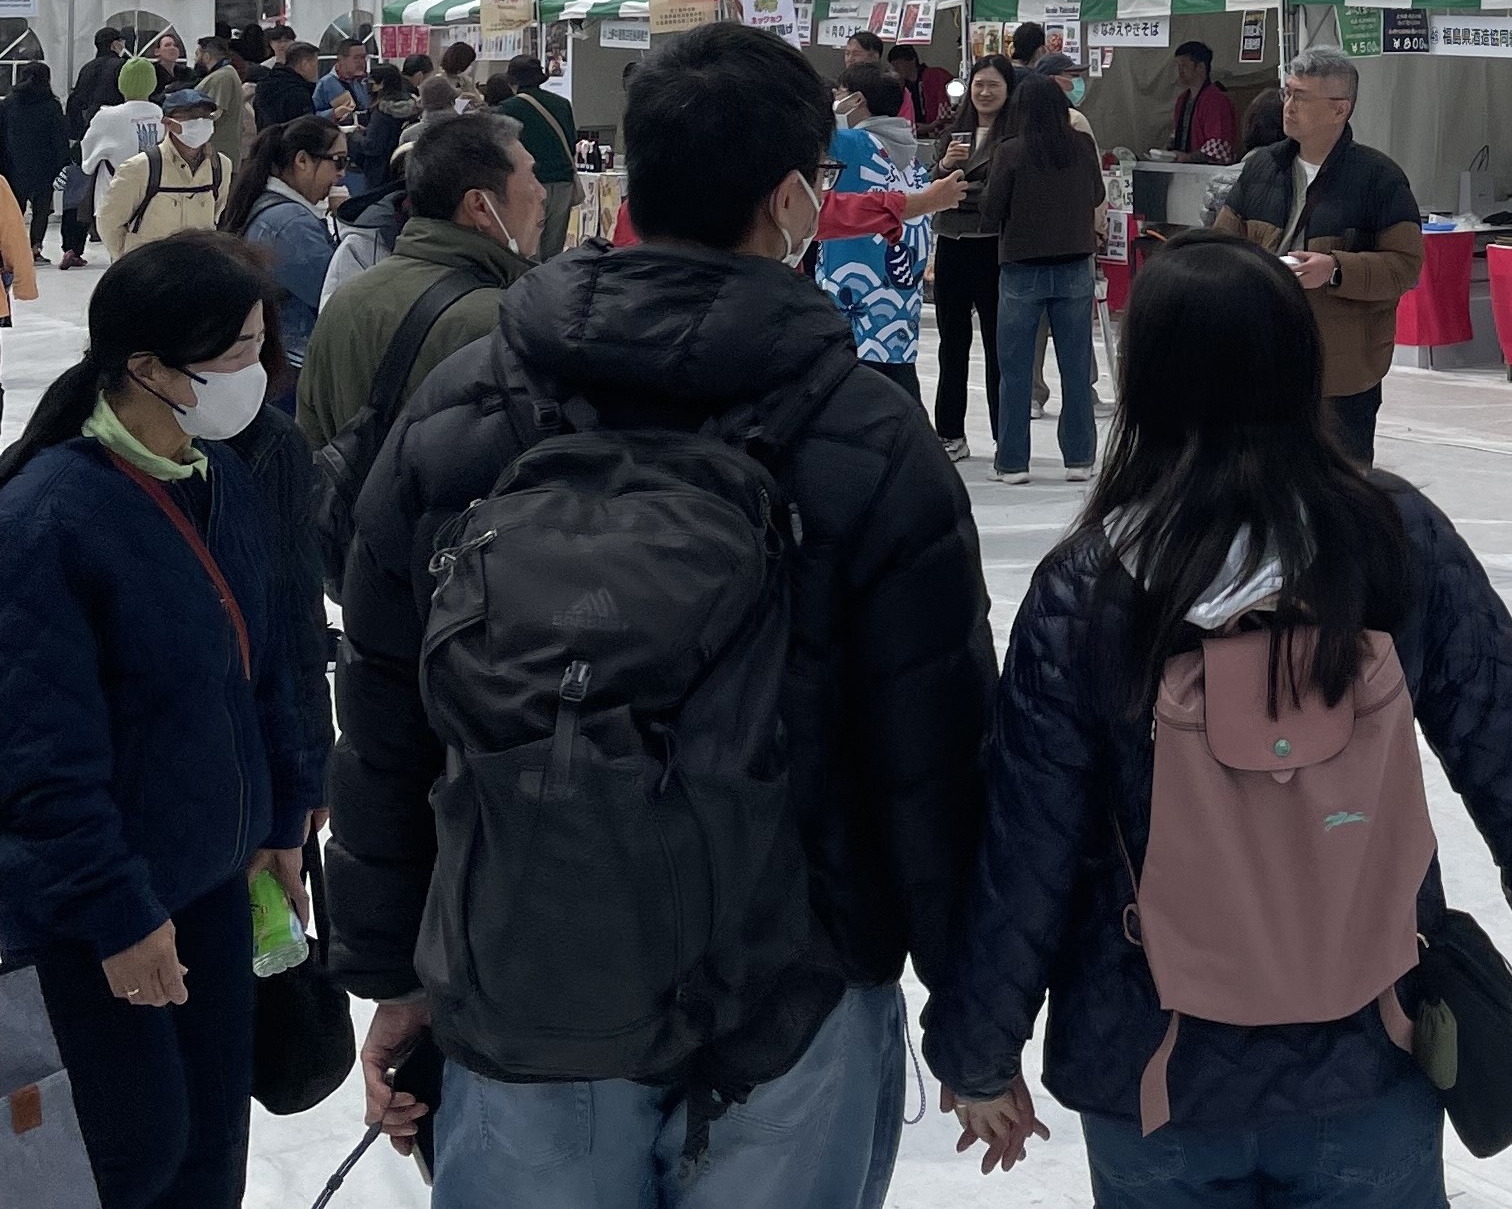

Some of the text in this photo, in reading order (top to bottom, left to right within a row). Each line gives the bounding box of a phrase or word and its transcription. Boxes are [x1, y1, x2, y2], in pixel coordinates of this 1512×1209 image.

[1100, 22, 1160, 37] なみえやきそば
